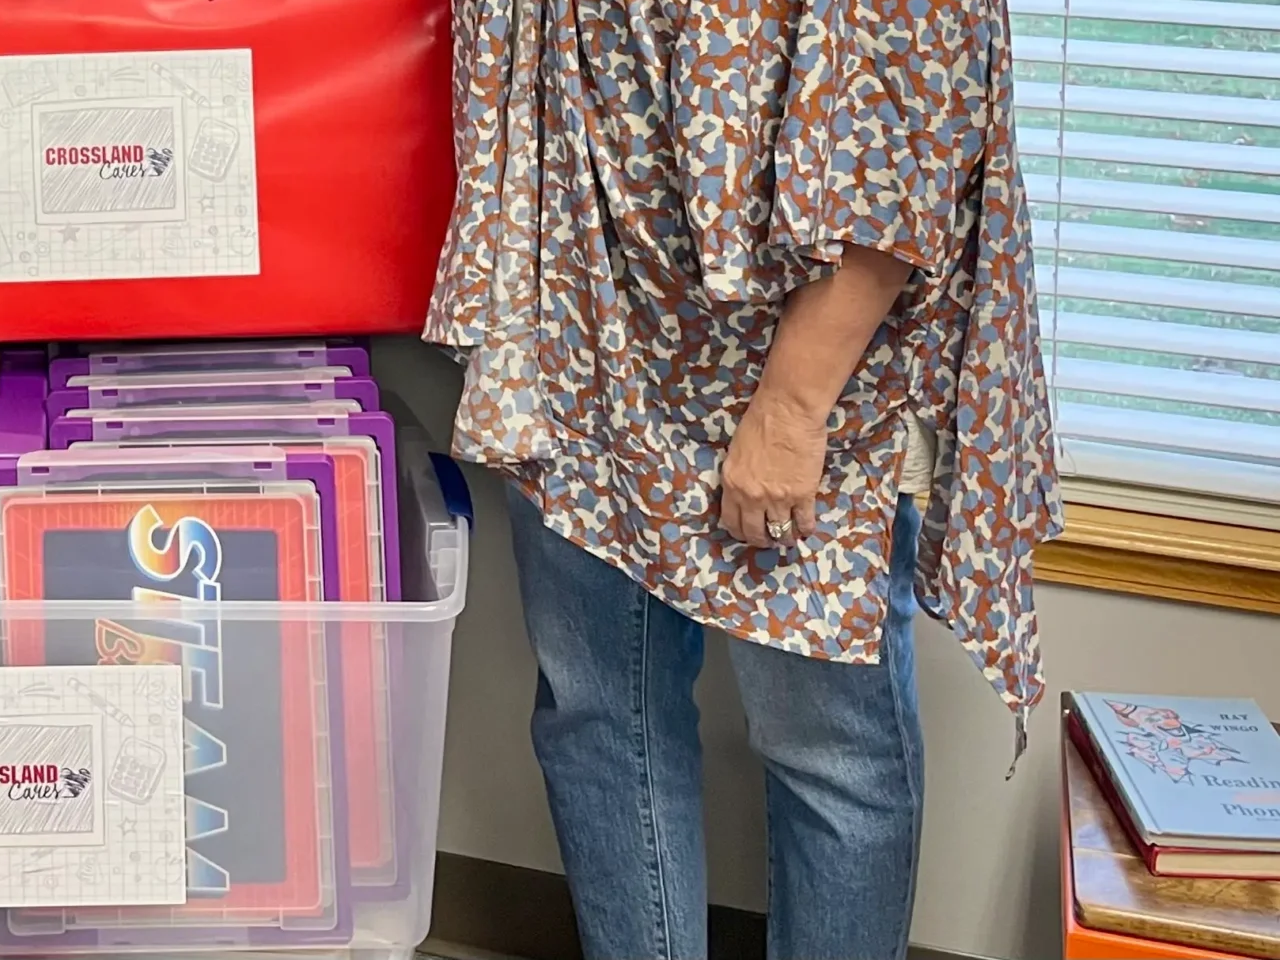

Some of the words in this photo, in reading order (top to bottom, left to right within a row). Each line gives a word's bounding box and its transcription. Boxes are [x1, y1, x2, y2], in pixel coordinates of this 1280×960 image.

[45, 145, 144, 165] CROSSLAND
[100, 160, 146, 180] Cares
[1207, 724, 1259, 732] WINGO
[8, 780, 62, 801] Cares
